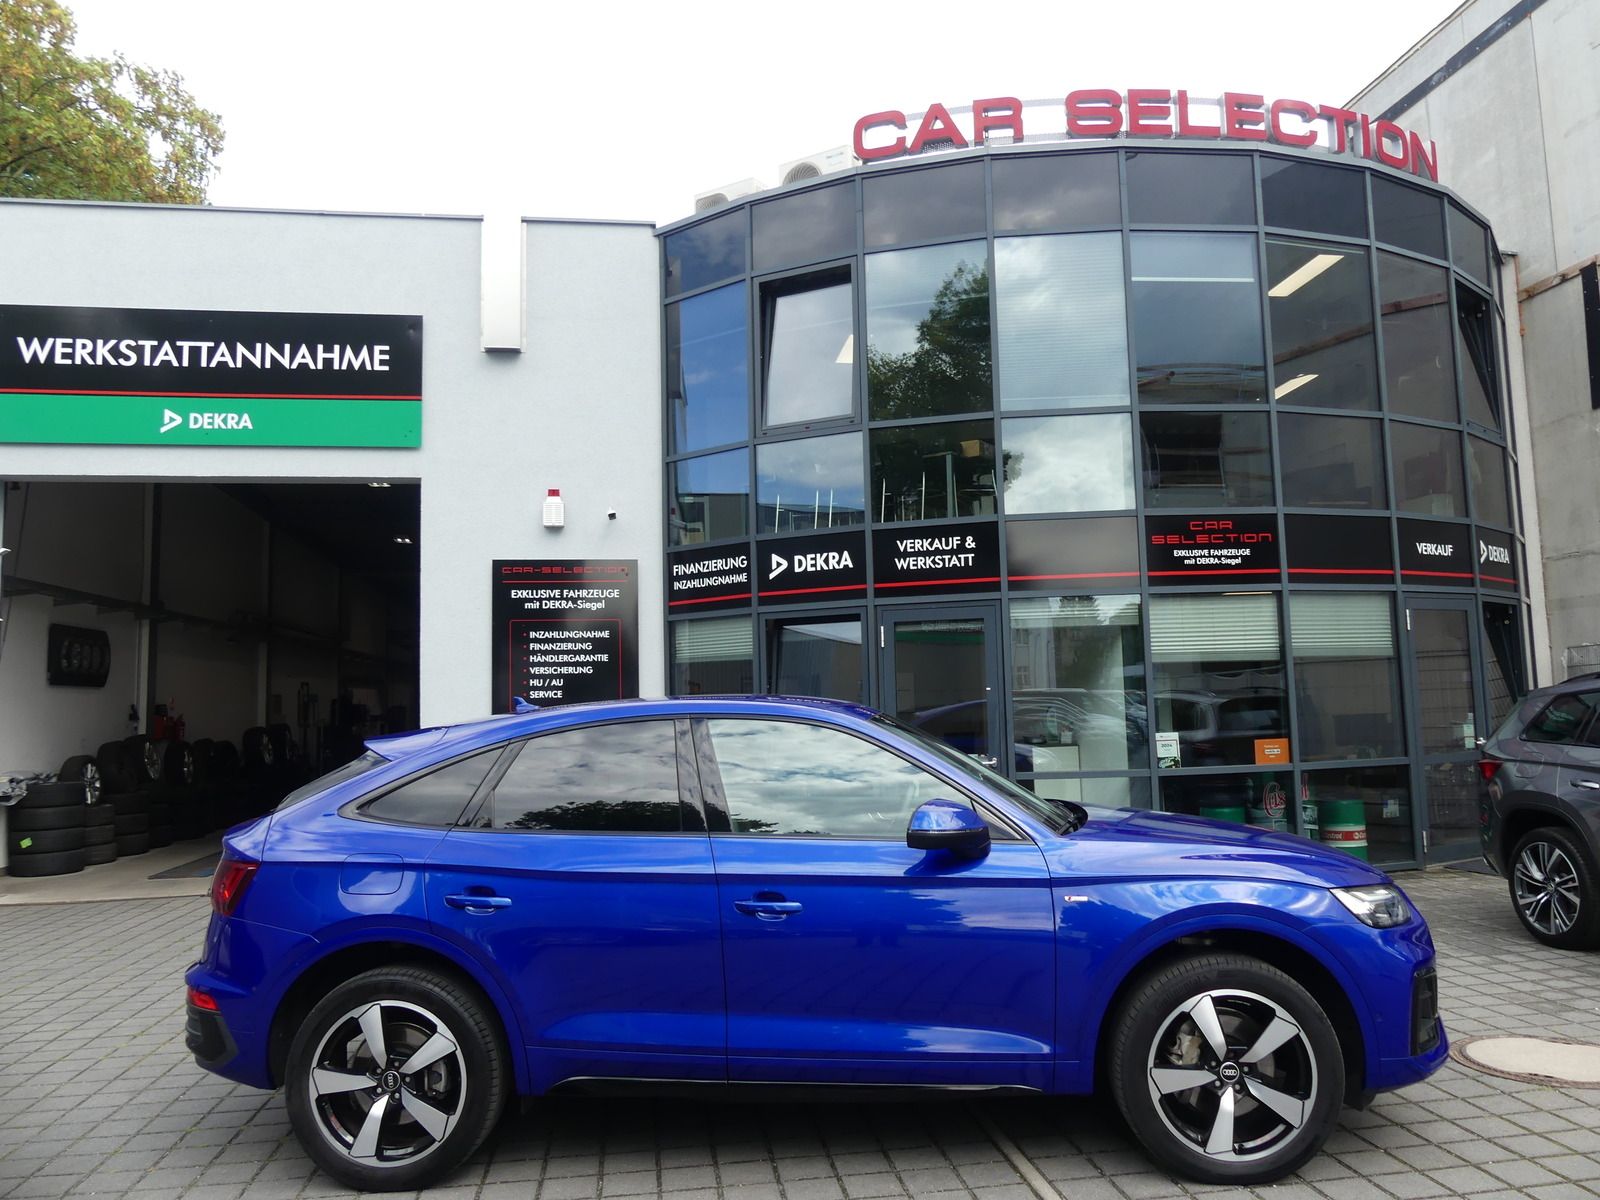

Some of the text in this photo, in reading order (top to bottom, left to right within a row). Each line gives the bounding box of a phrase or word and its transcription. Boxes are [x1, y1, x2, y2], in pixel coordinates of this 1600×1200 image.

[853, 89, 1438, 181] CAR SELECTION
[16, 336, 390, 371] WERKSTATTANNAHME
[189, 412, 253, 430] DEKRA
[1189, 520, 1233, 530] CAR
[896, 535, 976, 552] VERKAUF &
[1151, 533, 1272, 544] SELECTION
[1173, 548, 1251, 557] EXKLUSIVE FAHRZEUGE
[1415, 542, 1454, 556] VERKAUF
[1488, 545, 1510, 564] DEKRA
[673, 555, 748, 577] FINANZIERUNG
[793, 550, 853, 573] DEKRA
[894, 553, 975, 571] WERKSTATT
[1196, 557, 1241, 566] DEKRA-Siegel
[673, 572, 748, 590] INZAHLUNGNAHME
[511, 589, 620, 599] EXKLUSIVE FAHRZEUGE
[524, 600, 605, 611] mit DEKRA-Siegel
[529, 630, 610, 639] INZAHLUNGNAHME
[529, 642, 593, 651] FINANZIERUNG
[529, 653, 609, 662] HÄNDLERGARANTIE
[529, 666, 594, 674] VERSICHERUNG
[551, 678, 564, 686] AU
[529, 690, 563, 698] SERVICE
